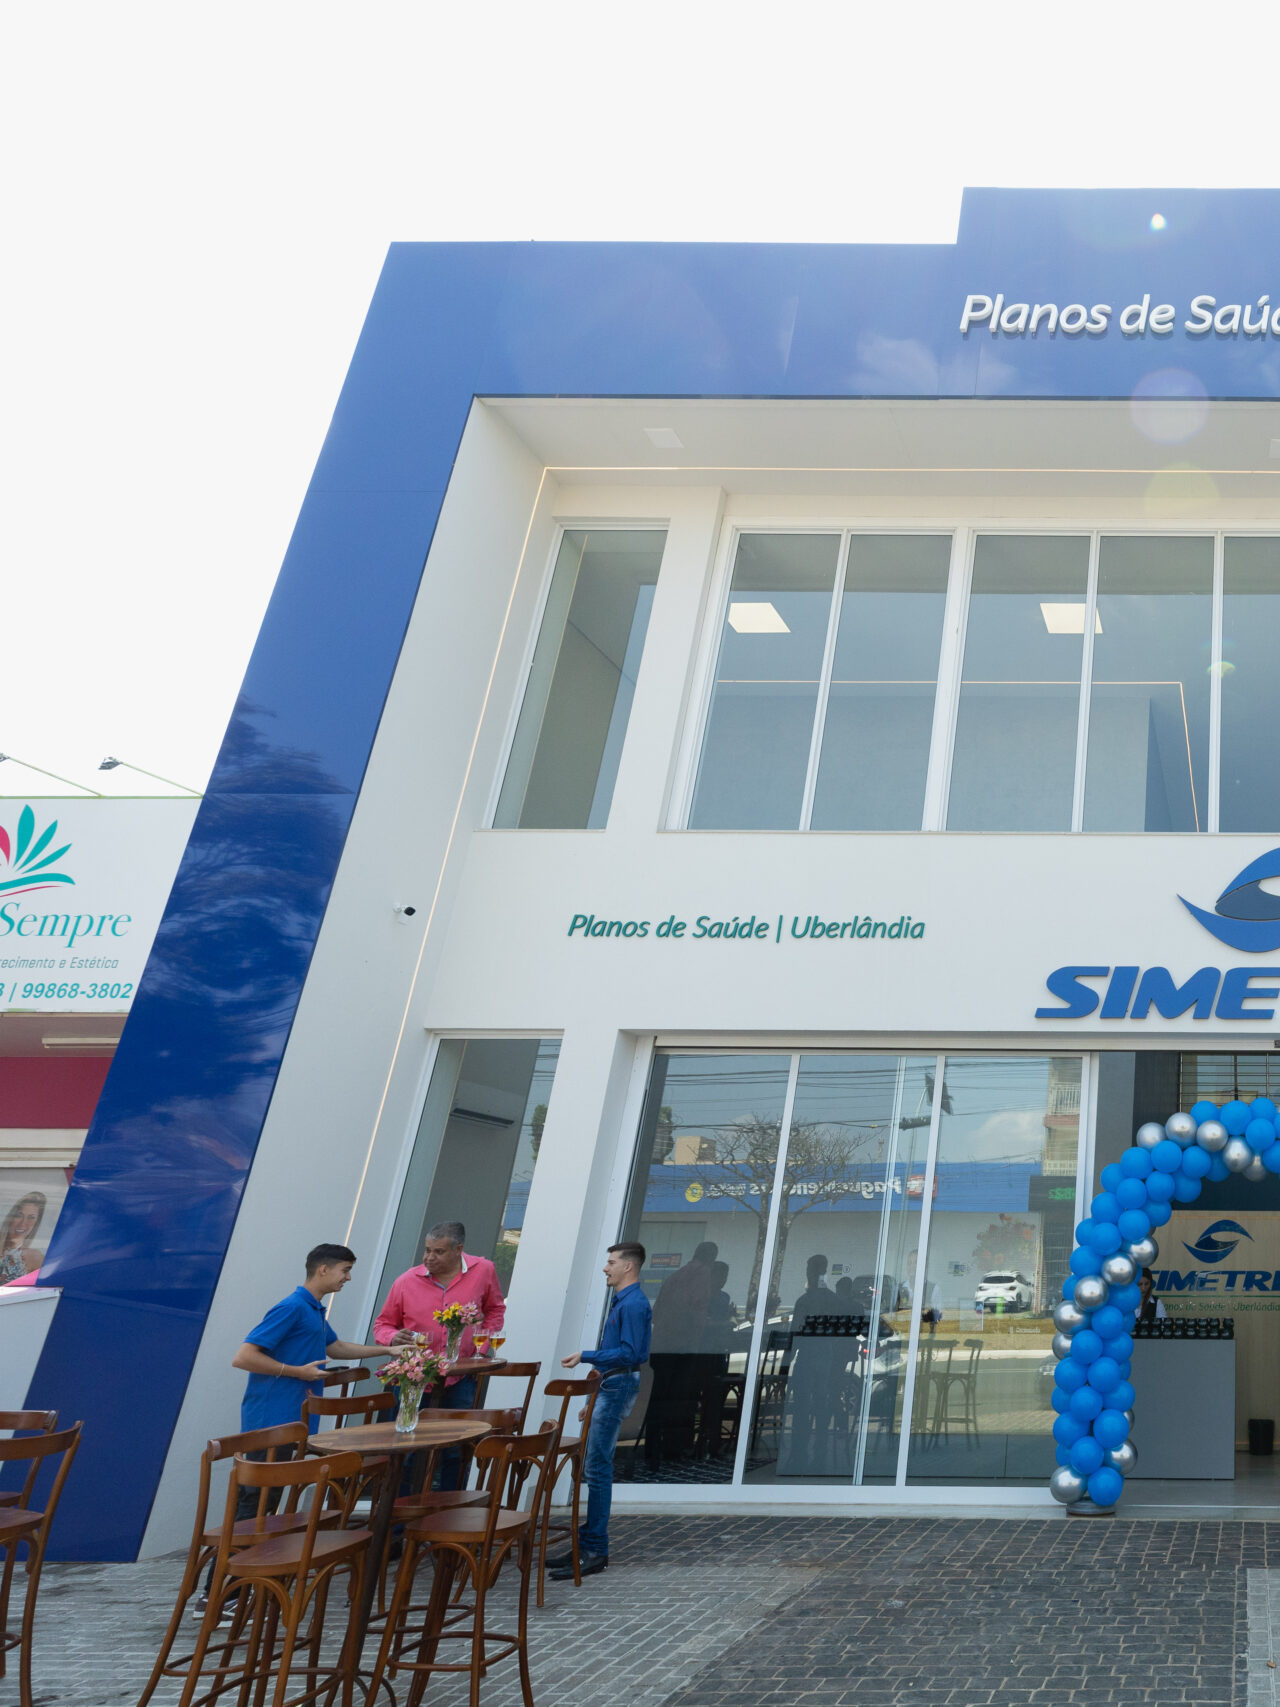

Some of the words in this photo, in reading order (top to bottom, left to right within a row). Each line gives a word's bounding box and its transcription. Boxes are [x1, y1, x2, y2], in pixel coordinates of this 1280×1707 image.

[958, 293, 1111, 333] Planos
[1119, 293, 1175, 333] de
[0, 902, 132, 949] Sempre
[568, 914, 650, 938] Planos
[656, 914, 688, 939] de
[692, 915, 770, 939] Saúde
[790, 914, 926, 940] Uberlândia
[59, 960, 66, 969] e
[70, 956, 119, 969] Estética
[21, 982, 134, 999] 99868-3802
